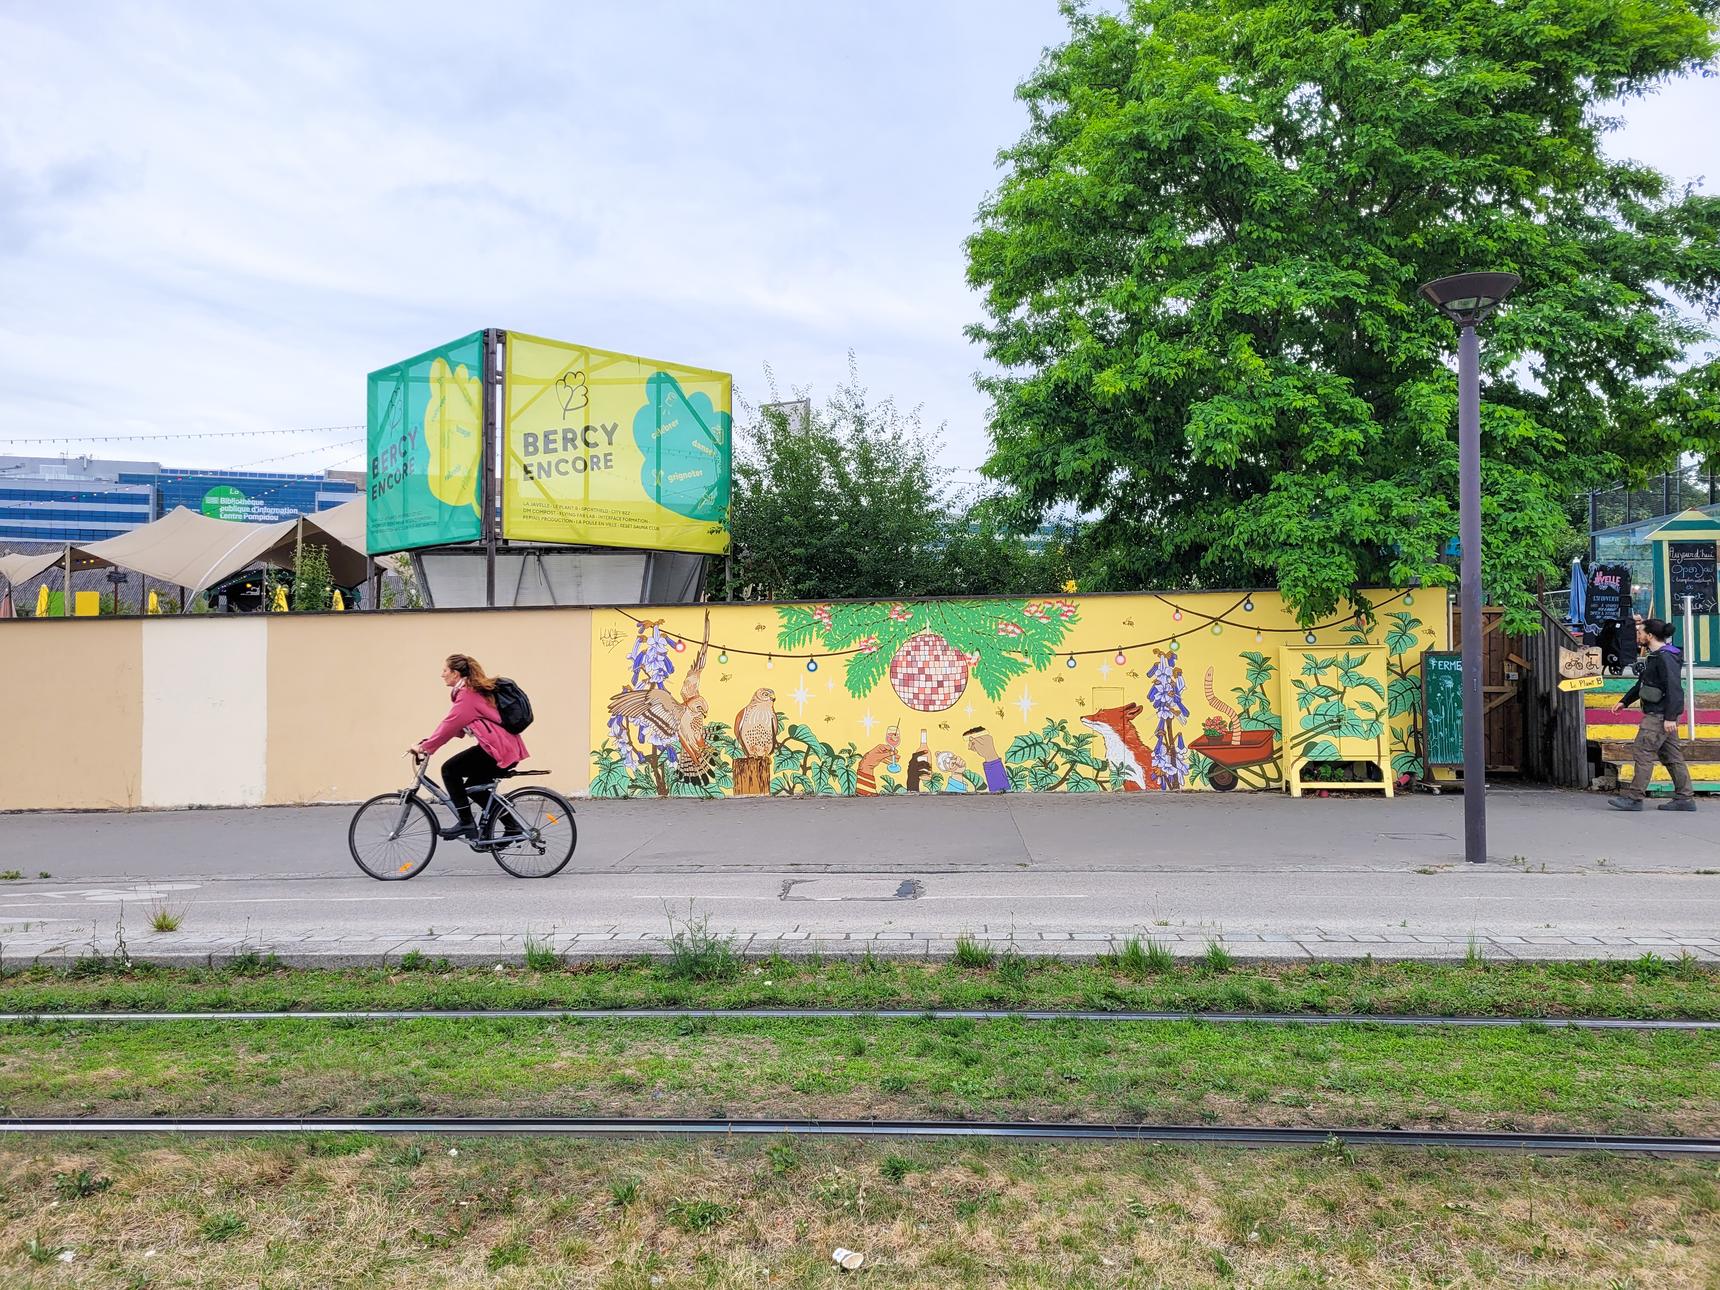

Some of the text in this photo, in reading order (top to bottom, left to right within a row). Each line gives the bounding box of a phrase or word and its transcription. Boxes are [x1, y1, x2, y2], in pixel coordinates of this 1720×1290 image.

[523, 422, 619, 458] BERCY
[372, 425, 418, 480] BERCY
[523, 452, 614, 481] ENCORE
[371, 456, 415, 502] ENCORE
[667, 469, 703, 483] grignoter
[220, 505, 298, 514] publique d'information
[220, 512, 279, 521] Centre Pompidou
[1671, 564, 1698, 578] Open
[1596, 677, 1603, 685] B
